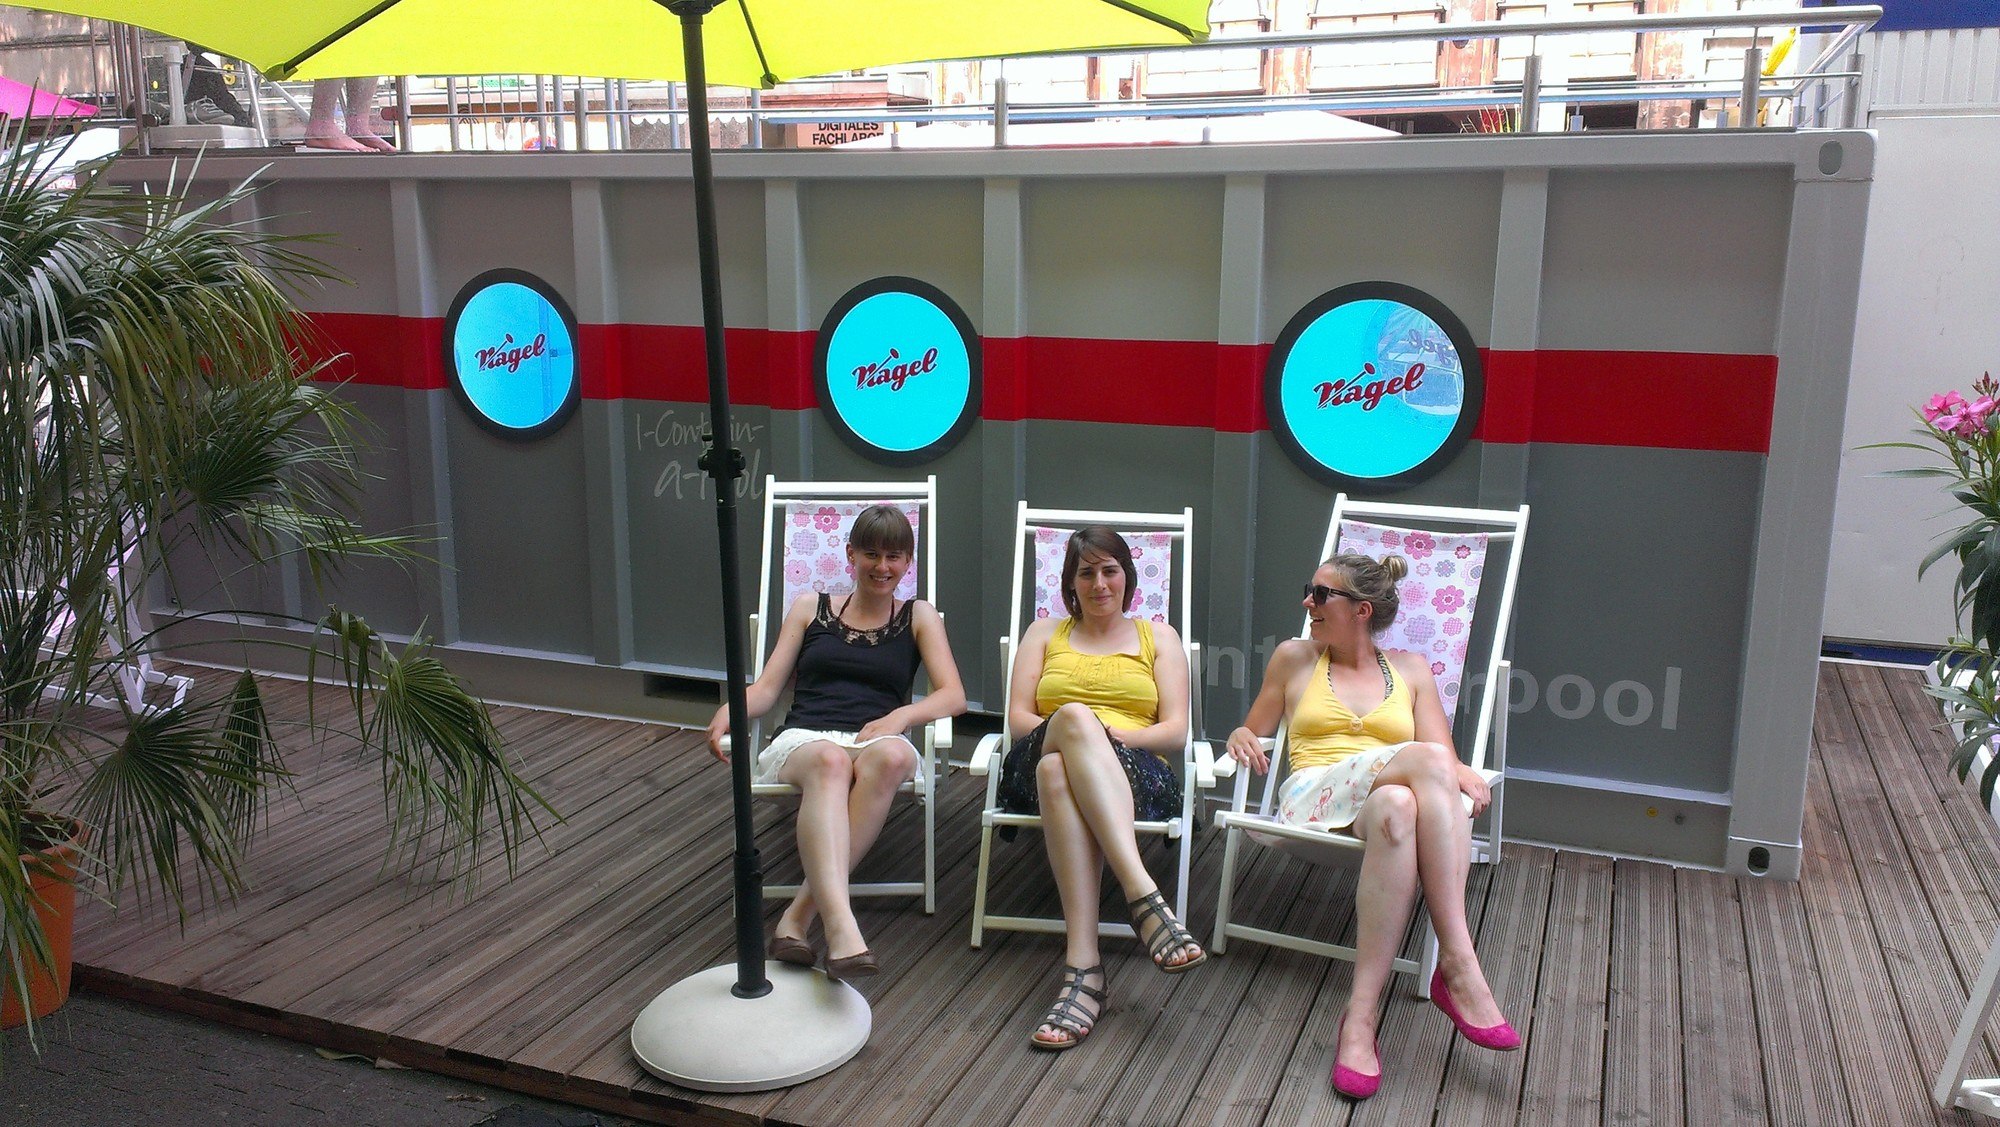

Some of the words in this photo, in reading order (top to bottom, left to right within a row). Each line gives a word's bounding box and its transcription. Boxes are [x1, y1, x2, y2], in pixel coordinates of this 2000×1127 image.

[818, 121, 879, 132] DIGITALES
[812, 132, 884, 145] FACHLAB
[636, 409, 764, 451] I-Contin-
